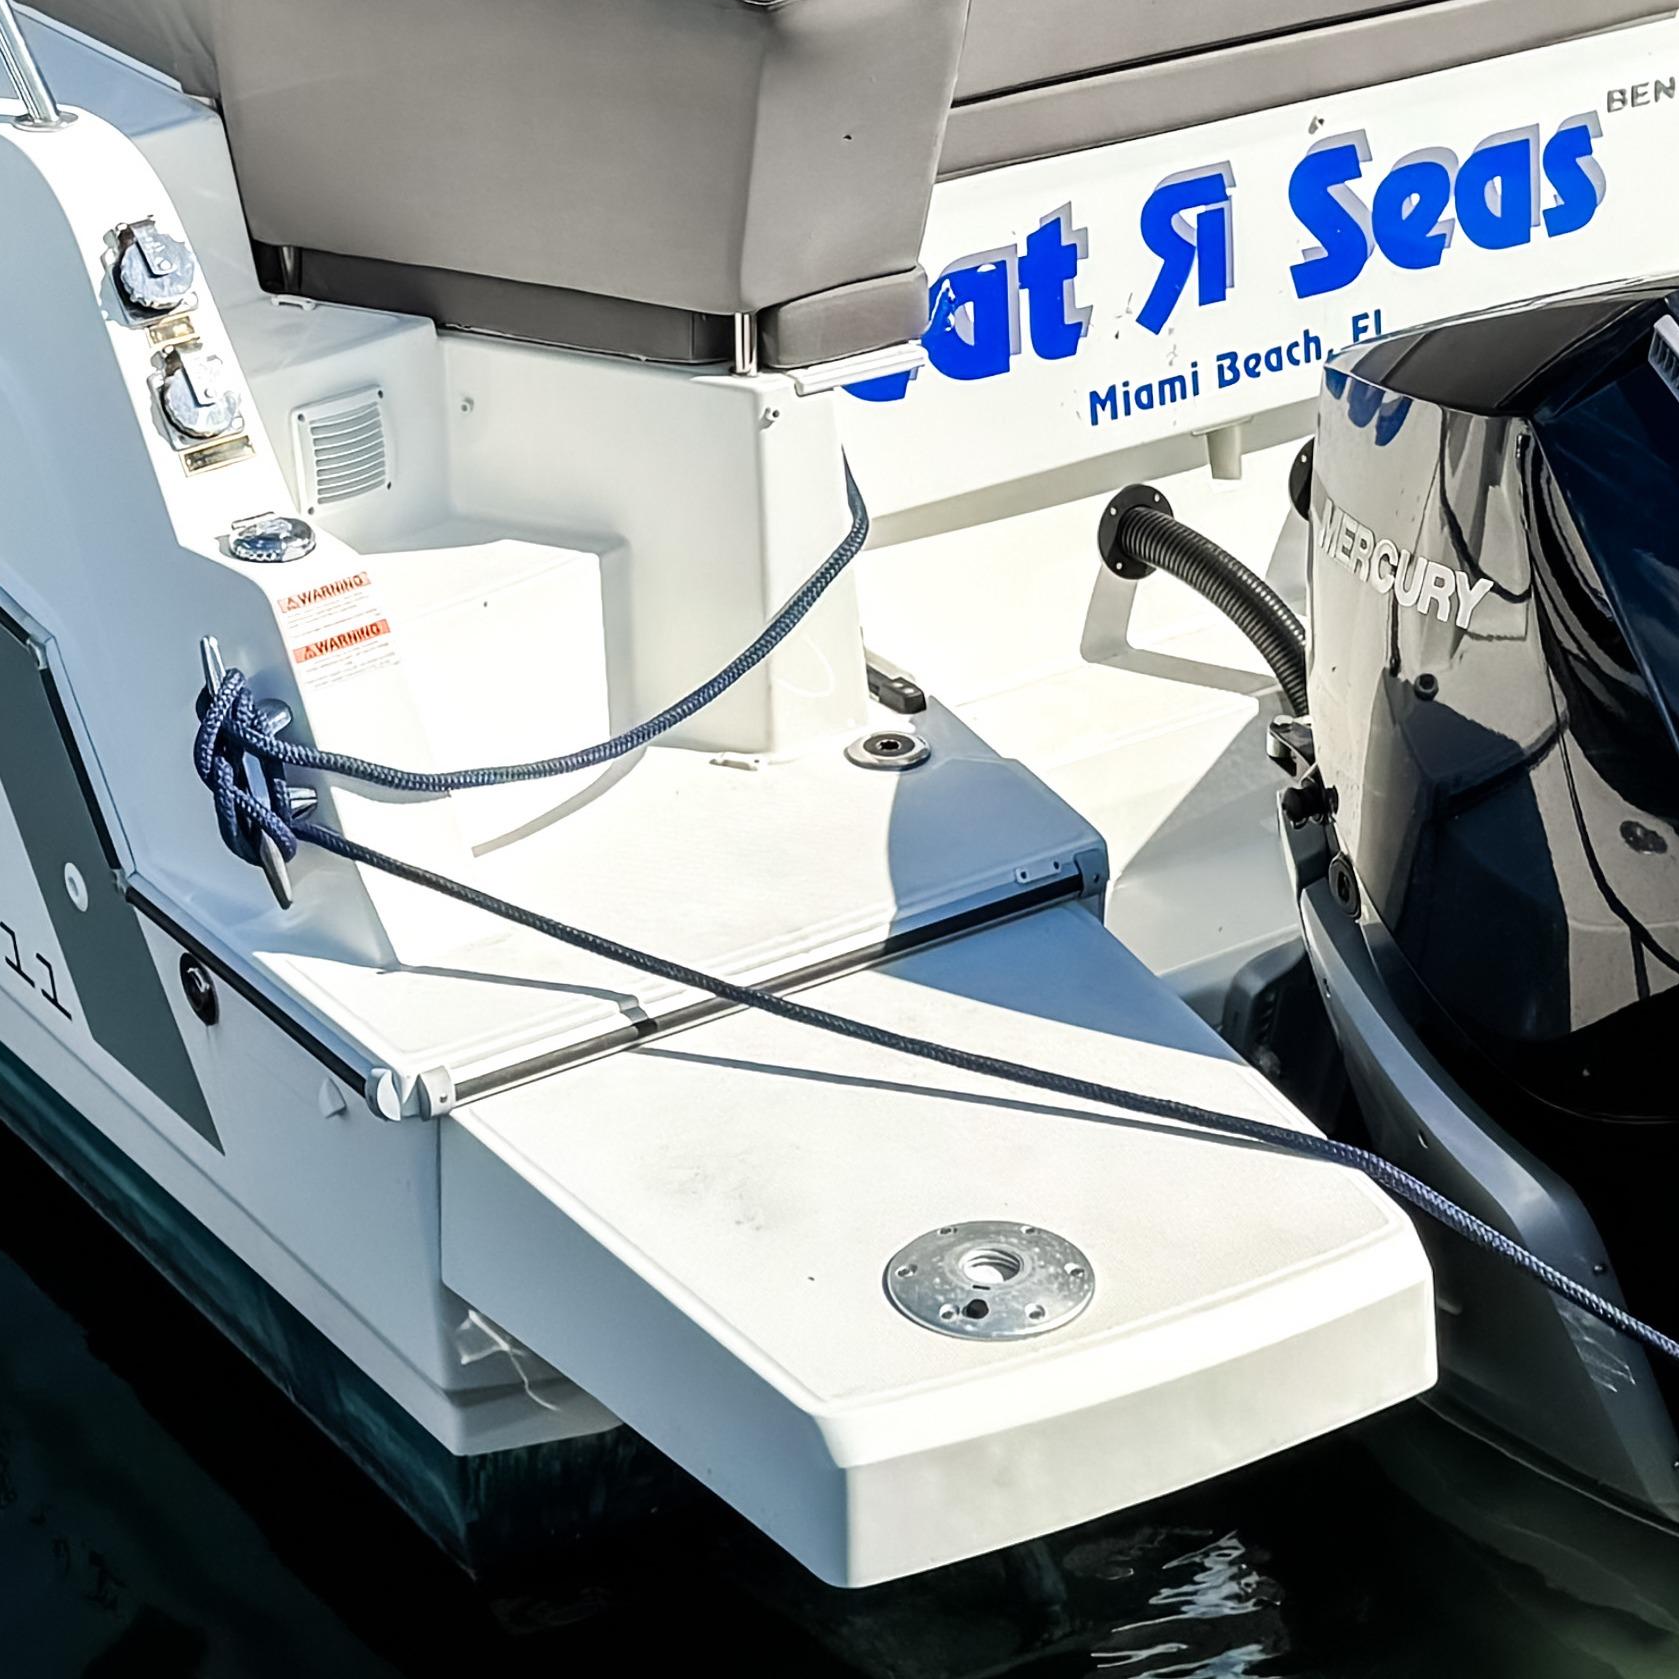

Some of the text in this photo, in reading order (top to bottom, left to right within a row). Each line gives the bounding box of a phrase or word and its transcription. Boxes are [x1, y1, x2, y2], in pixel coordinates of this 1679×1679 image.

[1288, 111, 1605, 298] Seas
[1089, 361, 1200, 426] Miami
[297, 574, 364, 606] WARNING
[1320, 496, 1495, 630] MERCURY
[314, 622, 381, 654] WARNING
[0, 921, 73, 1021] 11
